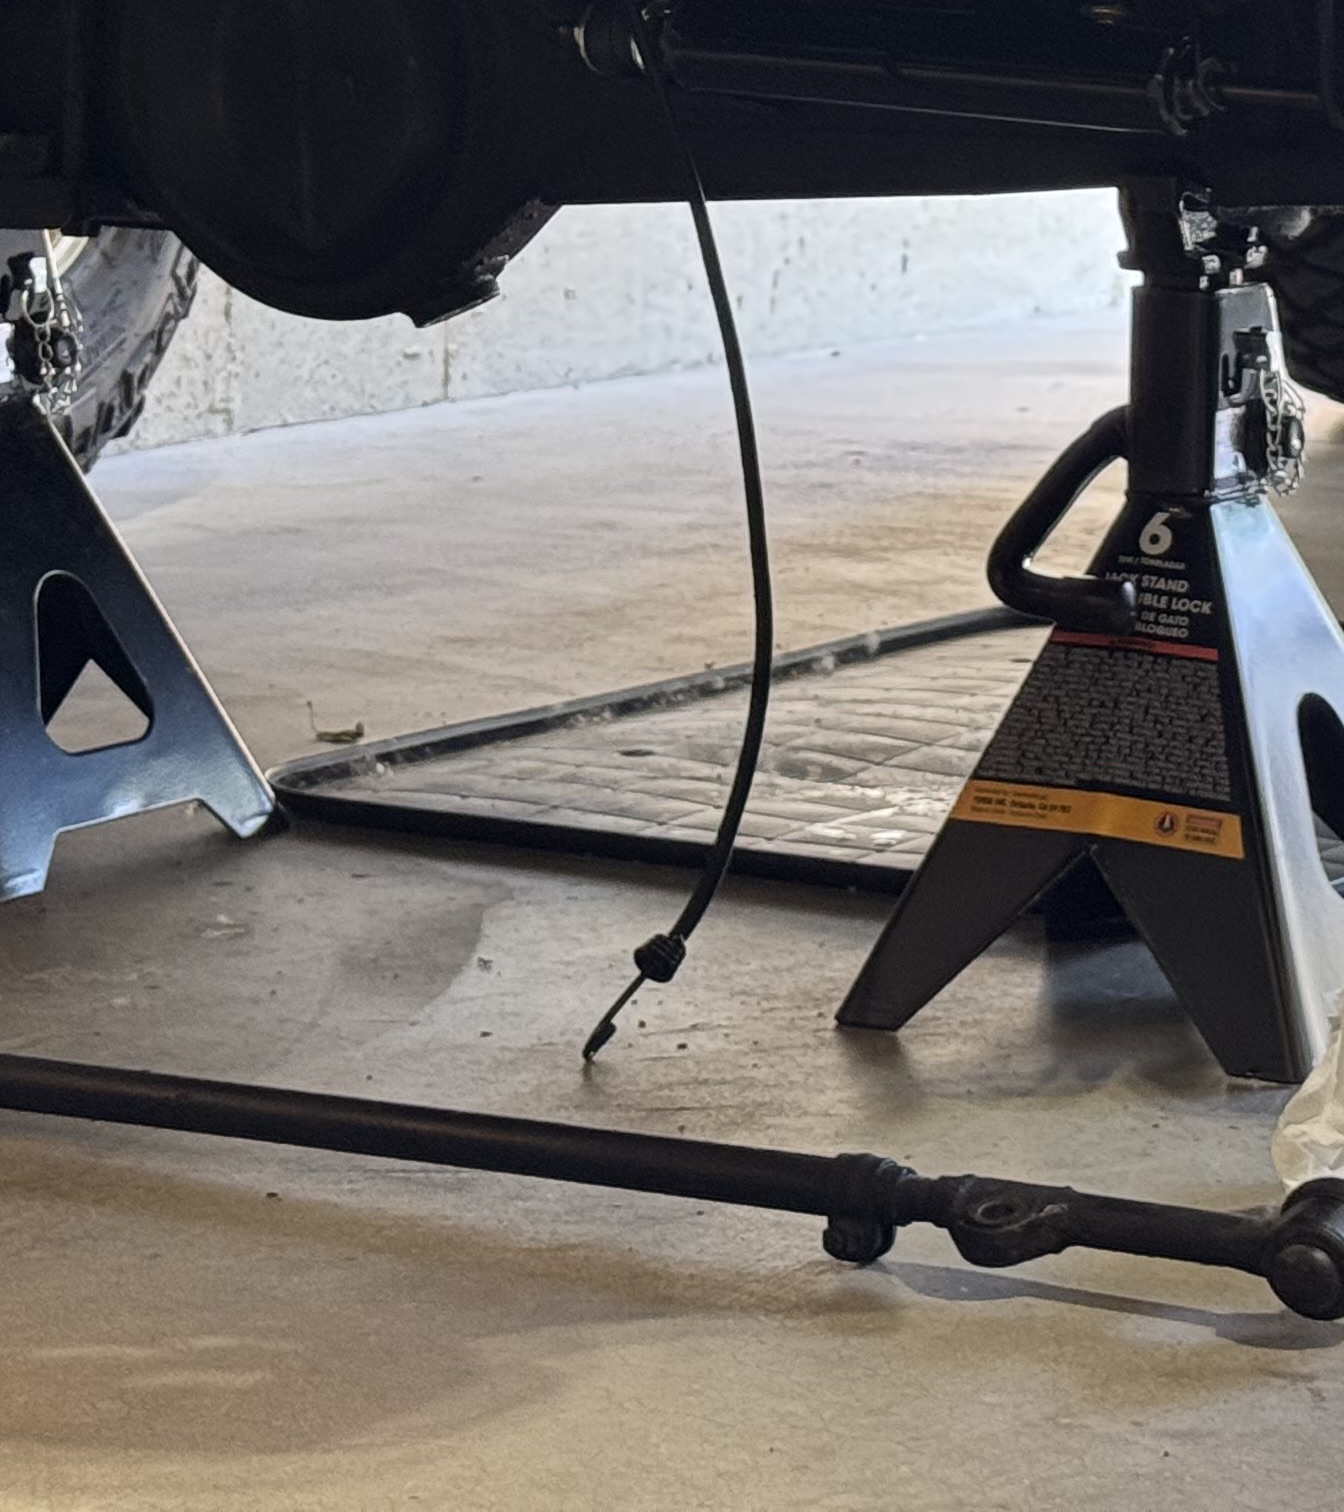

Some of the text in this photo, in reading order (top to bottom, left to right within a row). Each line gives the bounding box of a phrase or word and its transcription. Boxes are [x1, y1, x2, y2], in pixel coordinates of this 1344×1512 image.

[1139, 512, 1172, 555] 6
[1141, 575, 1190, 592] STAND
[1137, 592, 1213, 614] BLE LOCK
[1158, 613, 1190, 626] GATO
